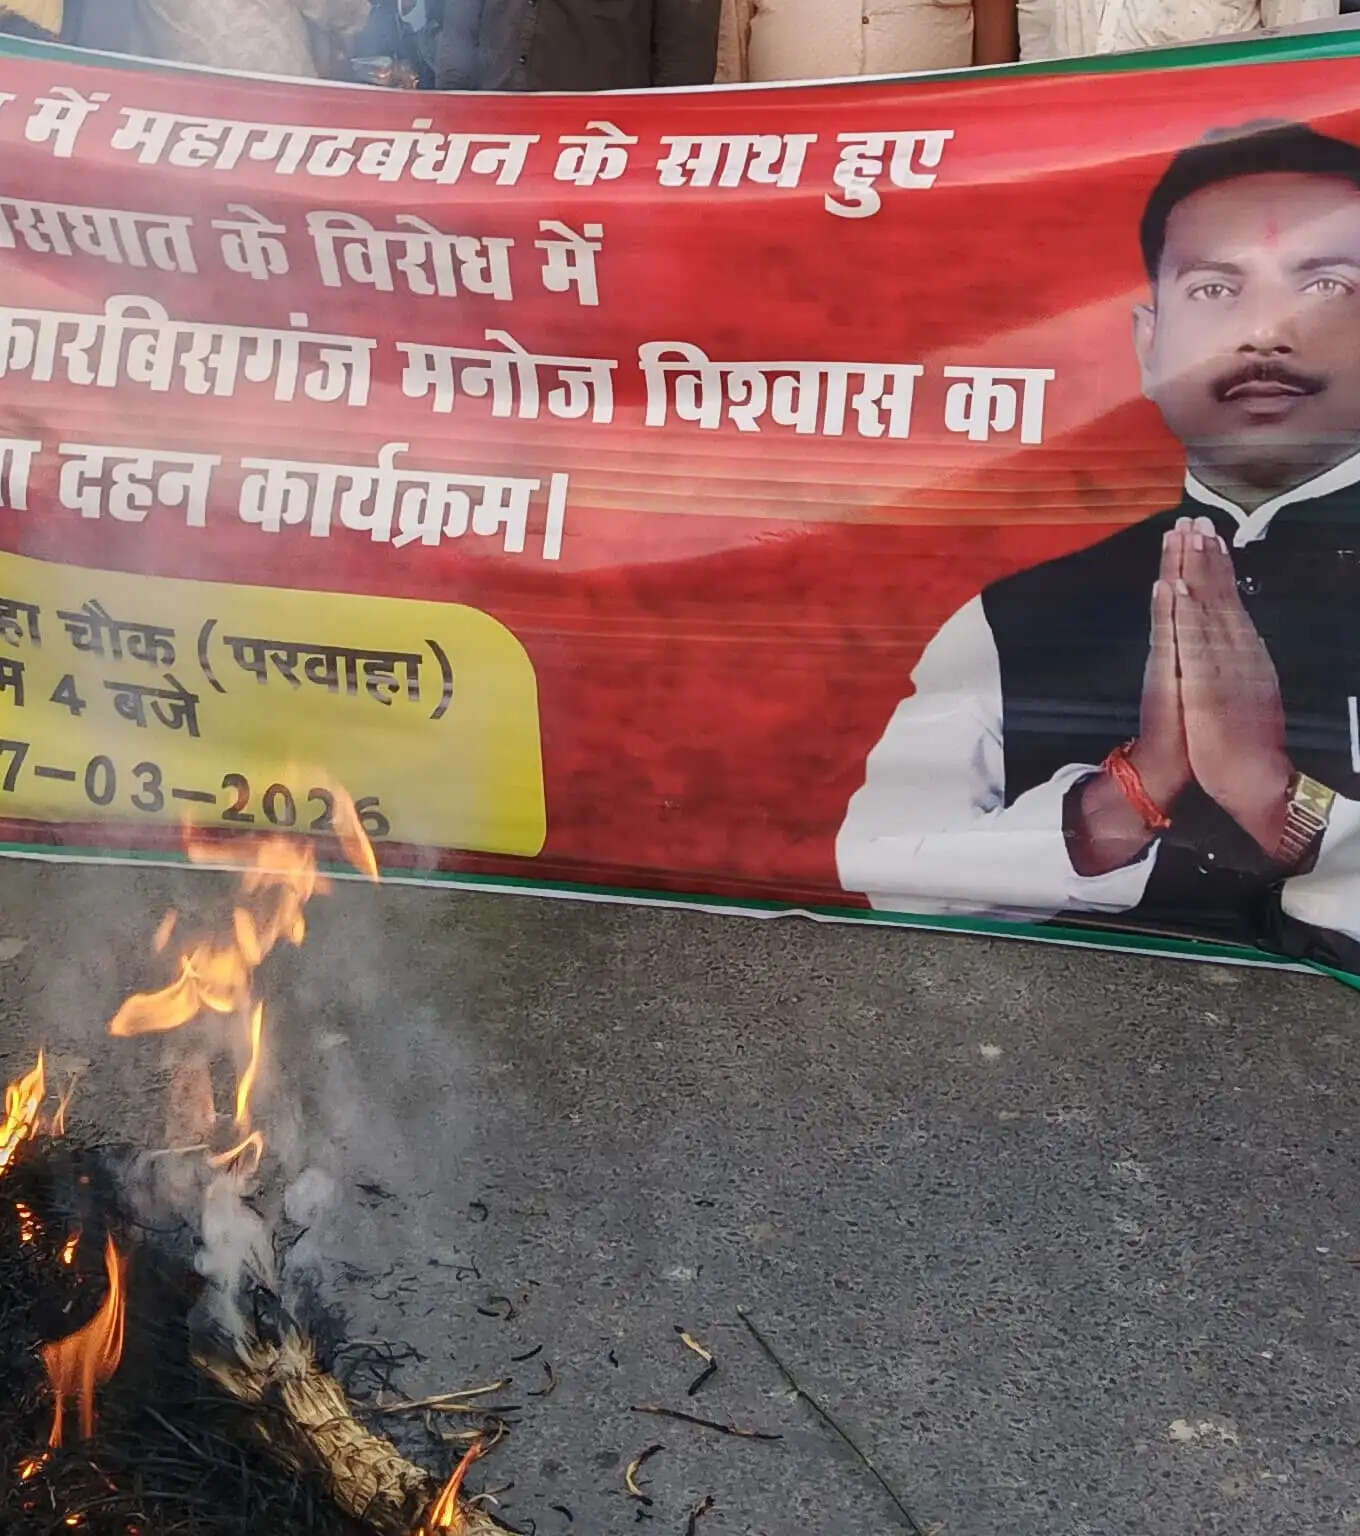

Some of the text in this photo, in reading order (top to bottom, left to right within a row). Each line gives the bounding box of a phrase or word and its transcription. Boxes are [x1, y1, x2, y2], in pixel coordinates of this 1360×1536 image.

[25, 86, 109, 157] में
[110, 107, 540, 186] महागठबंधन
[553, 121, 638, 186] के
[656, 133, 817, 188] साथ
[825, 128, 954, 218] हुए
[212, 203, 288, 279] के
[306, 211, 515, 303] विरोध
[534, 219, 604, 306] में
[397, 329, 618, 424] मनोज
[638, 341, 923, 438] विश्वास
[943, 365, 1055, 445] का
[57, 442, 222, 528] दहन
[49, 673, 87, 716] 4
[103, 673, 201, 738] बजे
[57, 596, 176, 668] चौक
[197, 618, 454, 720] (परवाहा)
